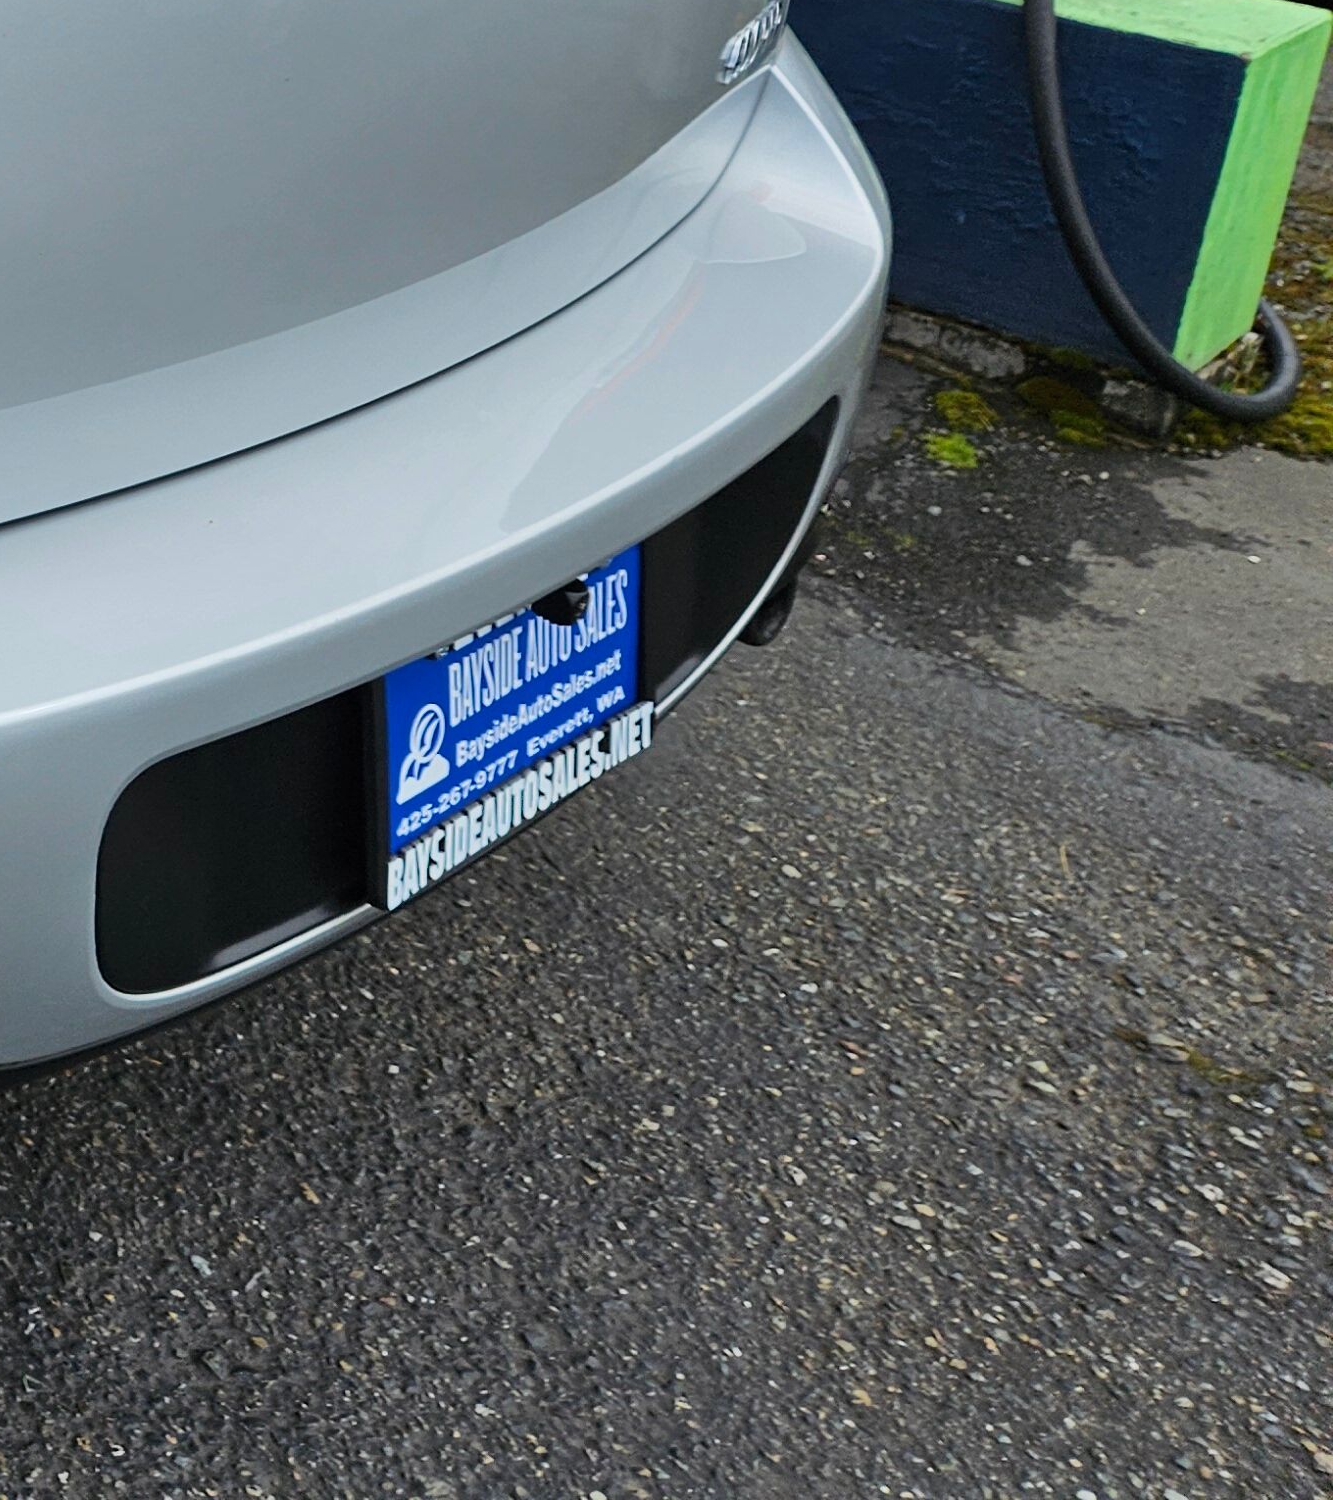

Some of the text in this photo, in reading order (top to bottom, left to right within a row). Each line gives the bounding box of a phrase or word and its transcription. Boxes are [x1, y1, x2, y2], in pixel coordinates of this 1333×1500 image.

[448, 626, 523, 728] BAYSIDE
[455, 649, 622, 768] BaysideAutoSales.net
[387, 700, 655, 912] BAYSIDEAUTOSALES.NET
[396, 685, 626, 837] 425-267-9777 Everett, WA
